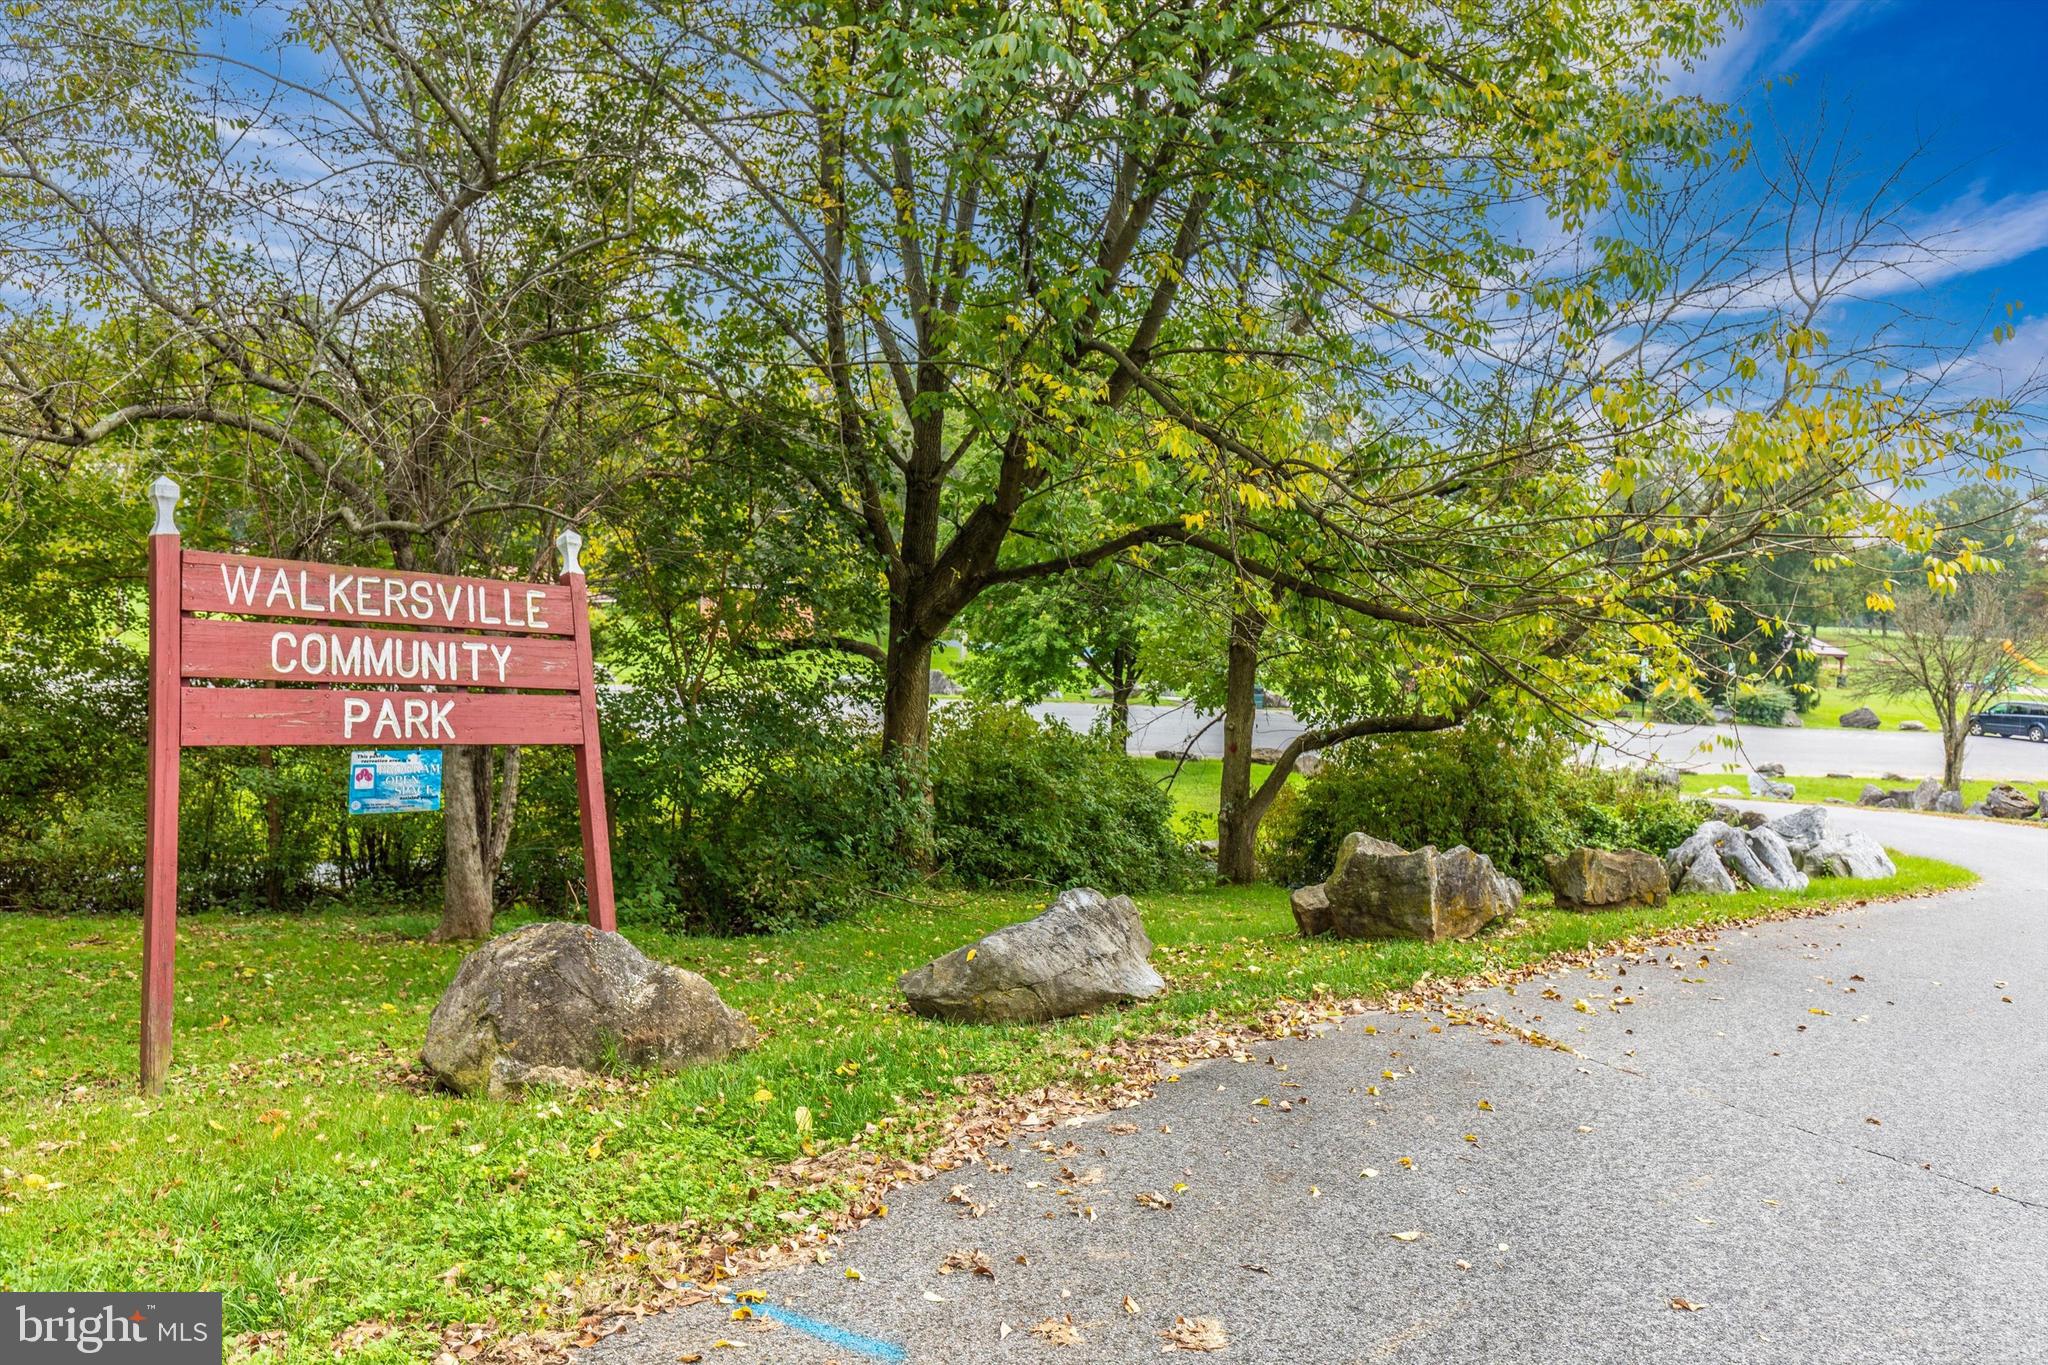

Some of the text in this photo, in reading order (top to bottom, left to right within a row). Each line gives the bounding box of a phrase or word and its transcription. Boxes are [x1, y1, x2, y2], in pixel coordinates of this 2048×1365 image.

[220, 562, 549, 629] WALKERSVILLE
[271, 631, 512, 683] COMMUNITY
[343, 697, 456, 740] PARK
[385, 775, 420, 785] OPEN
[394, 785, 435, 796] SPACE
